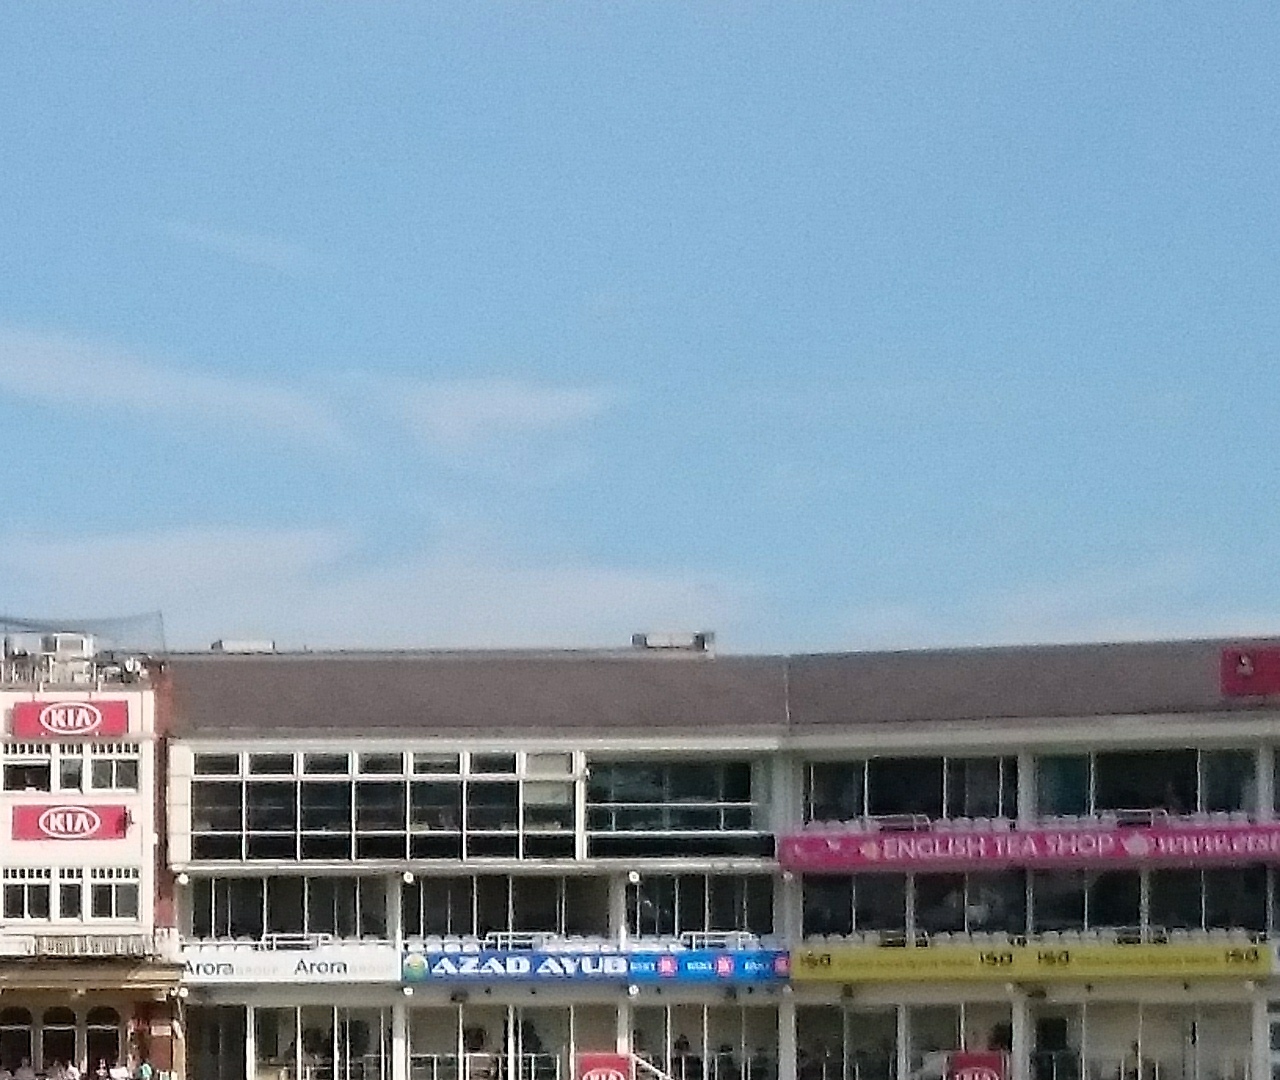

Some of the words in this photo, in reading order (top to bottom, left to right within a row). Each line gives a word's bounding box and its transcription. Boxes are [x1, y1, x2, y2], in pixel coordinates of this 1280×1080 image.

[883, 836, 985, 859] ENGLISH
[995, 834, 1038, 857] TEA
[1045, 833, 1113, 856] SHOP
[184, 960, 234, 976] Arora
[294, 958, 348, 975] Arora
[431, 957, 531, 974] AZAD
[536, 957, 628, 974] AYUB
